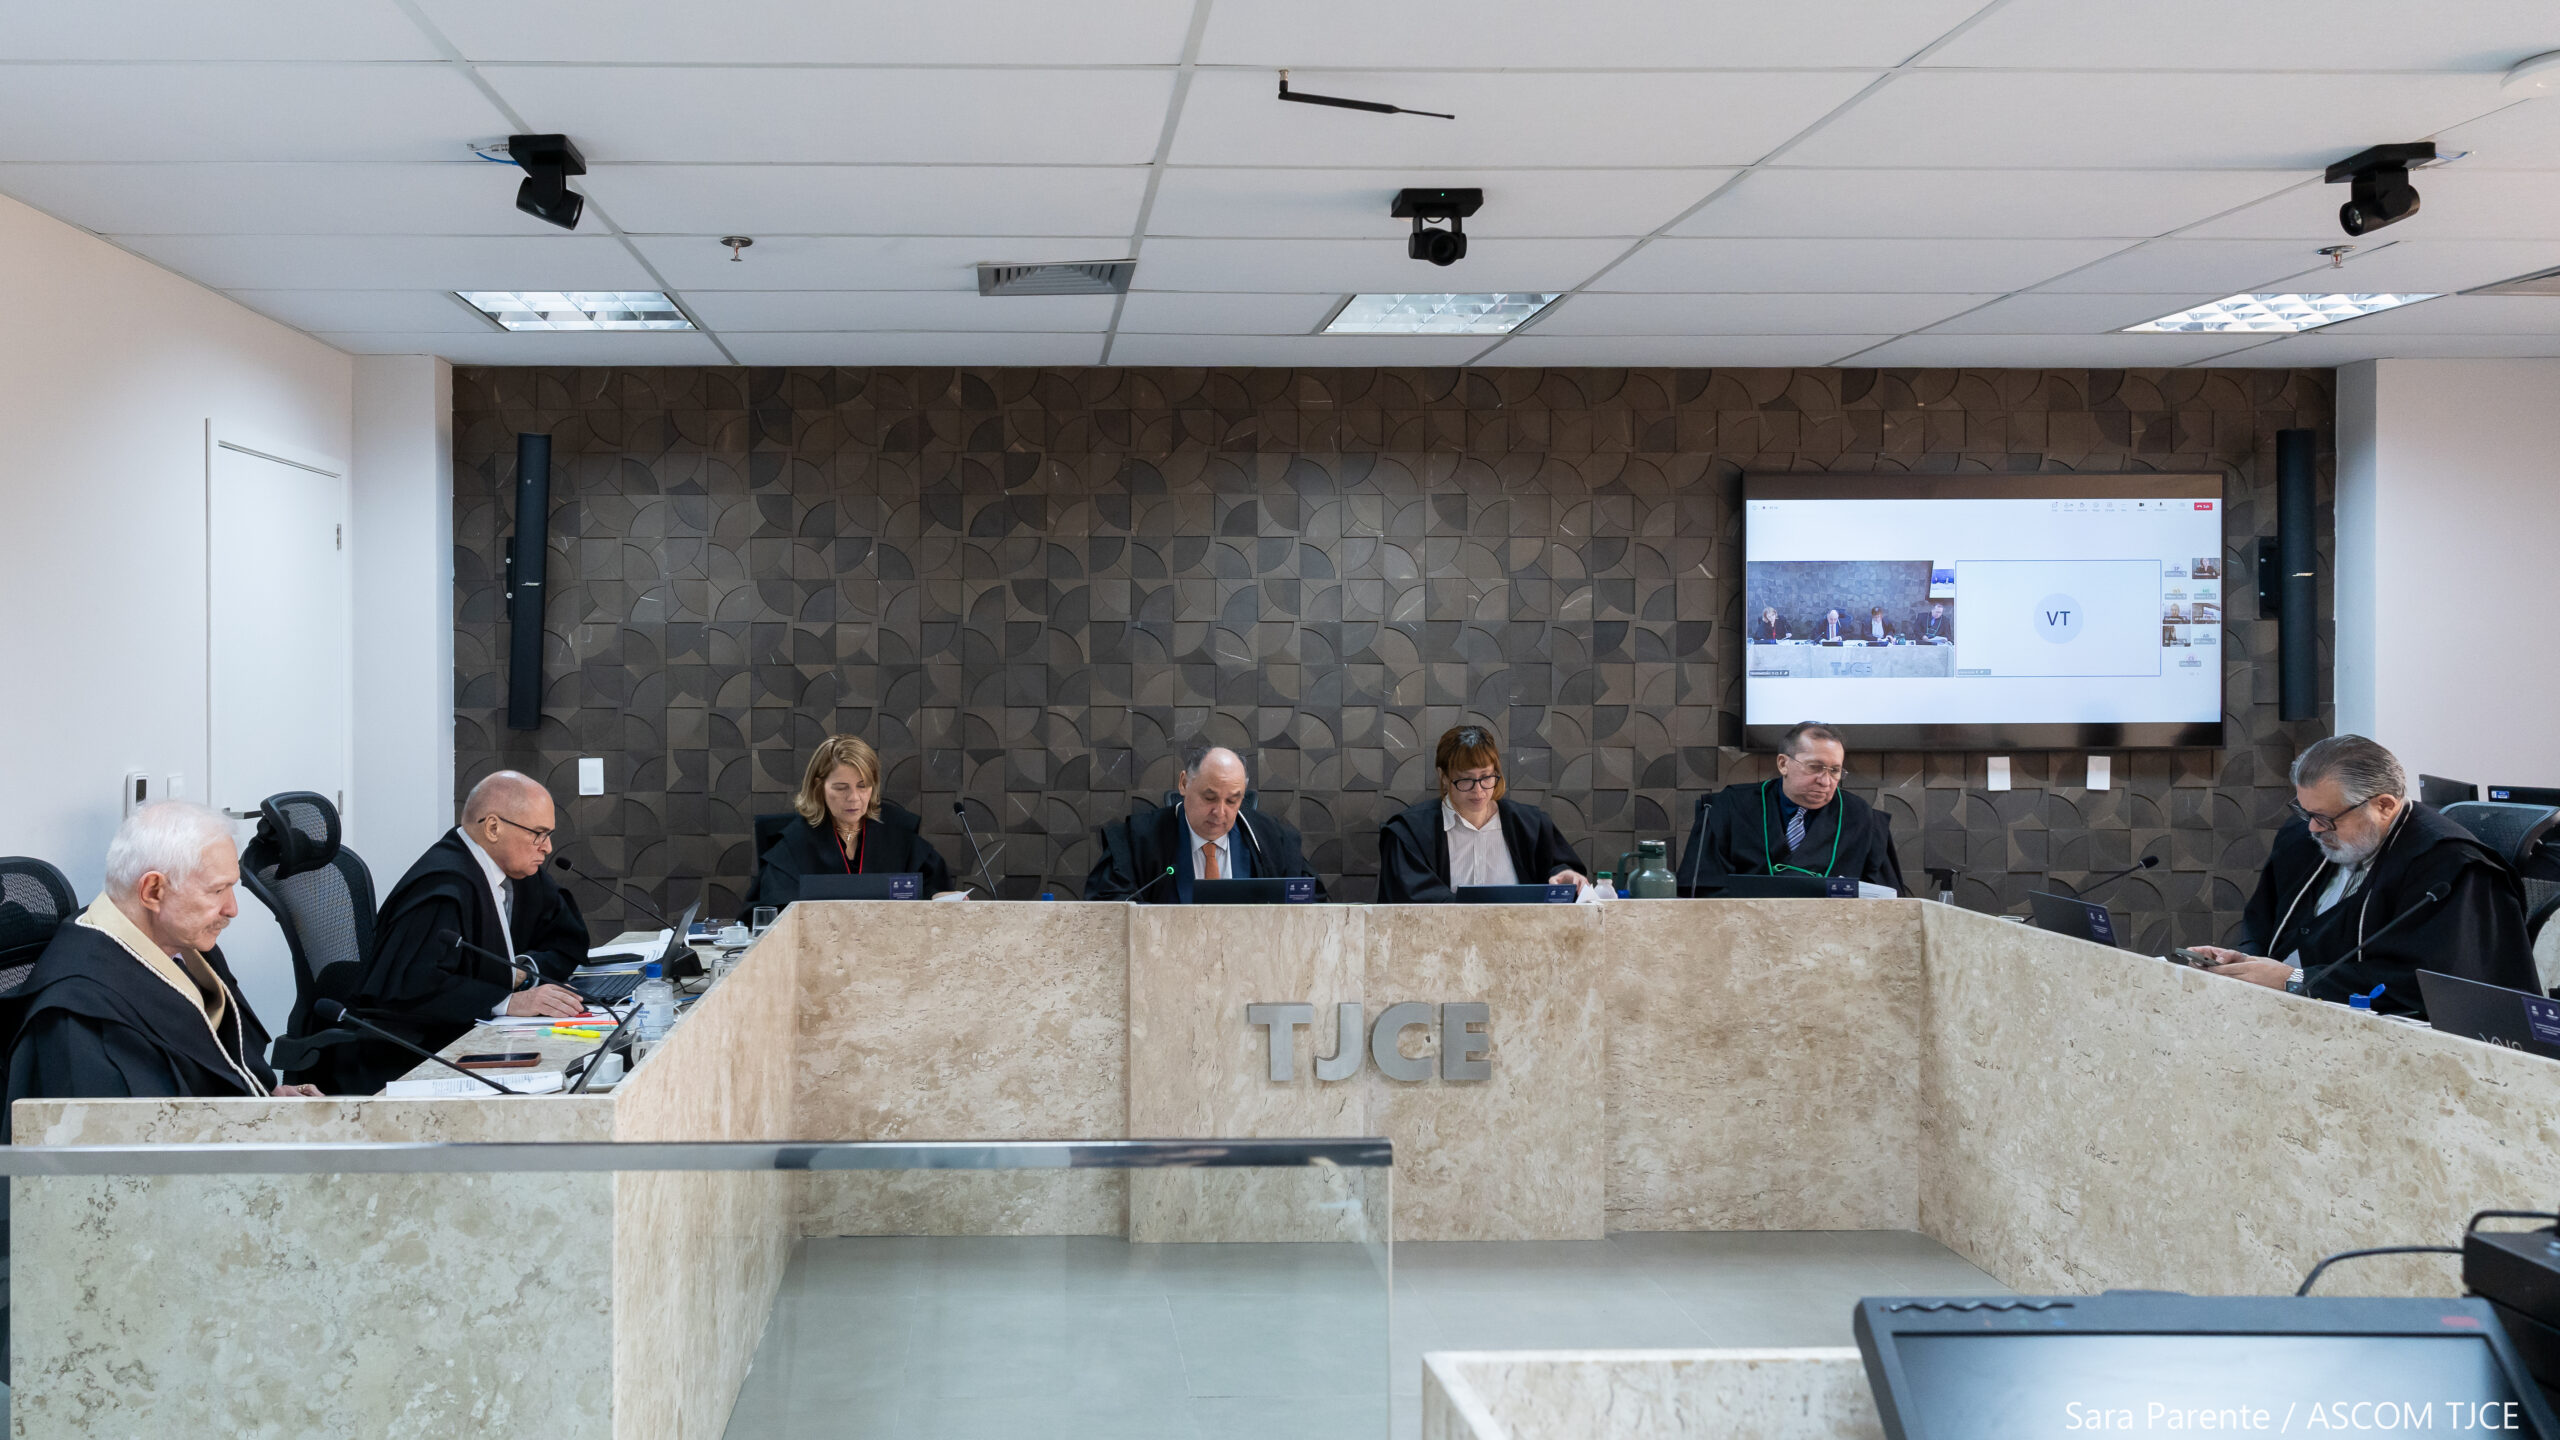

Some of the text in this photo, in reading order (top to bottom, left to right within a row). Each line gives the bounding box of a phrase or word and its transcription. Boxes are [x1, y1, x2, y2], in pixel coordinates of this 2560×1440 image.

[2046, 610, 2071, 626] VT
[1830, 662, 1873, 676] TJCE
[1247, 1002, 1492, 1082] TJCE
